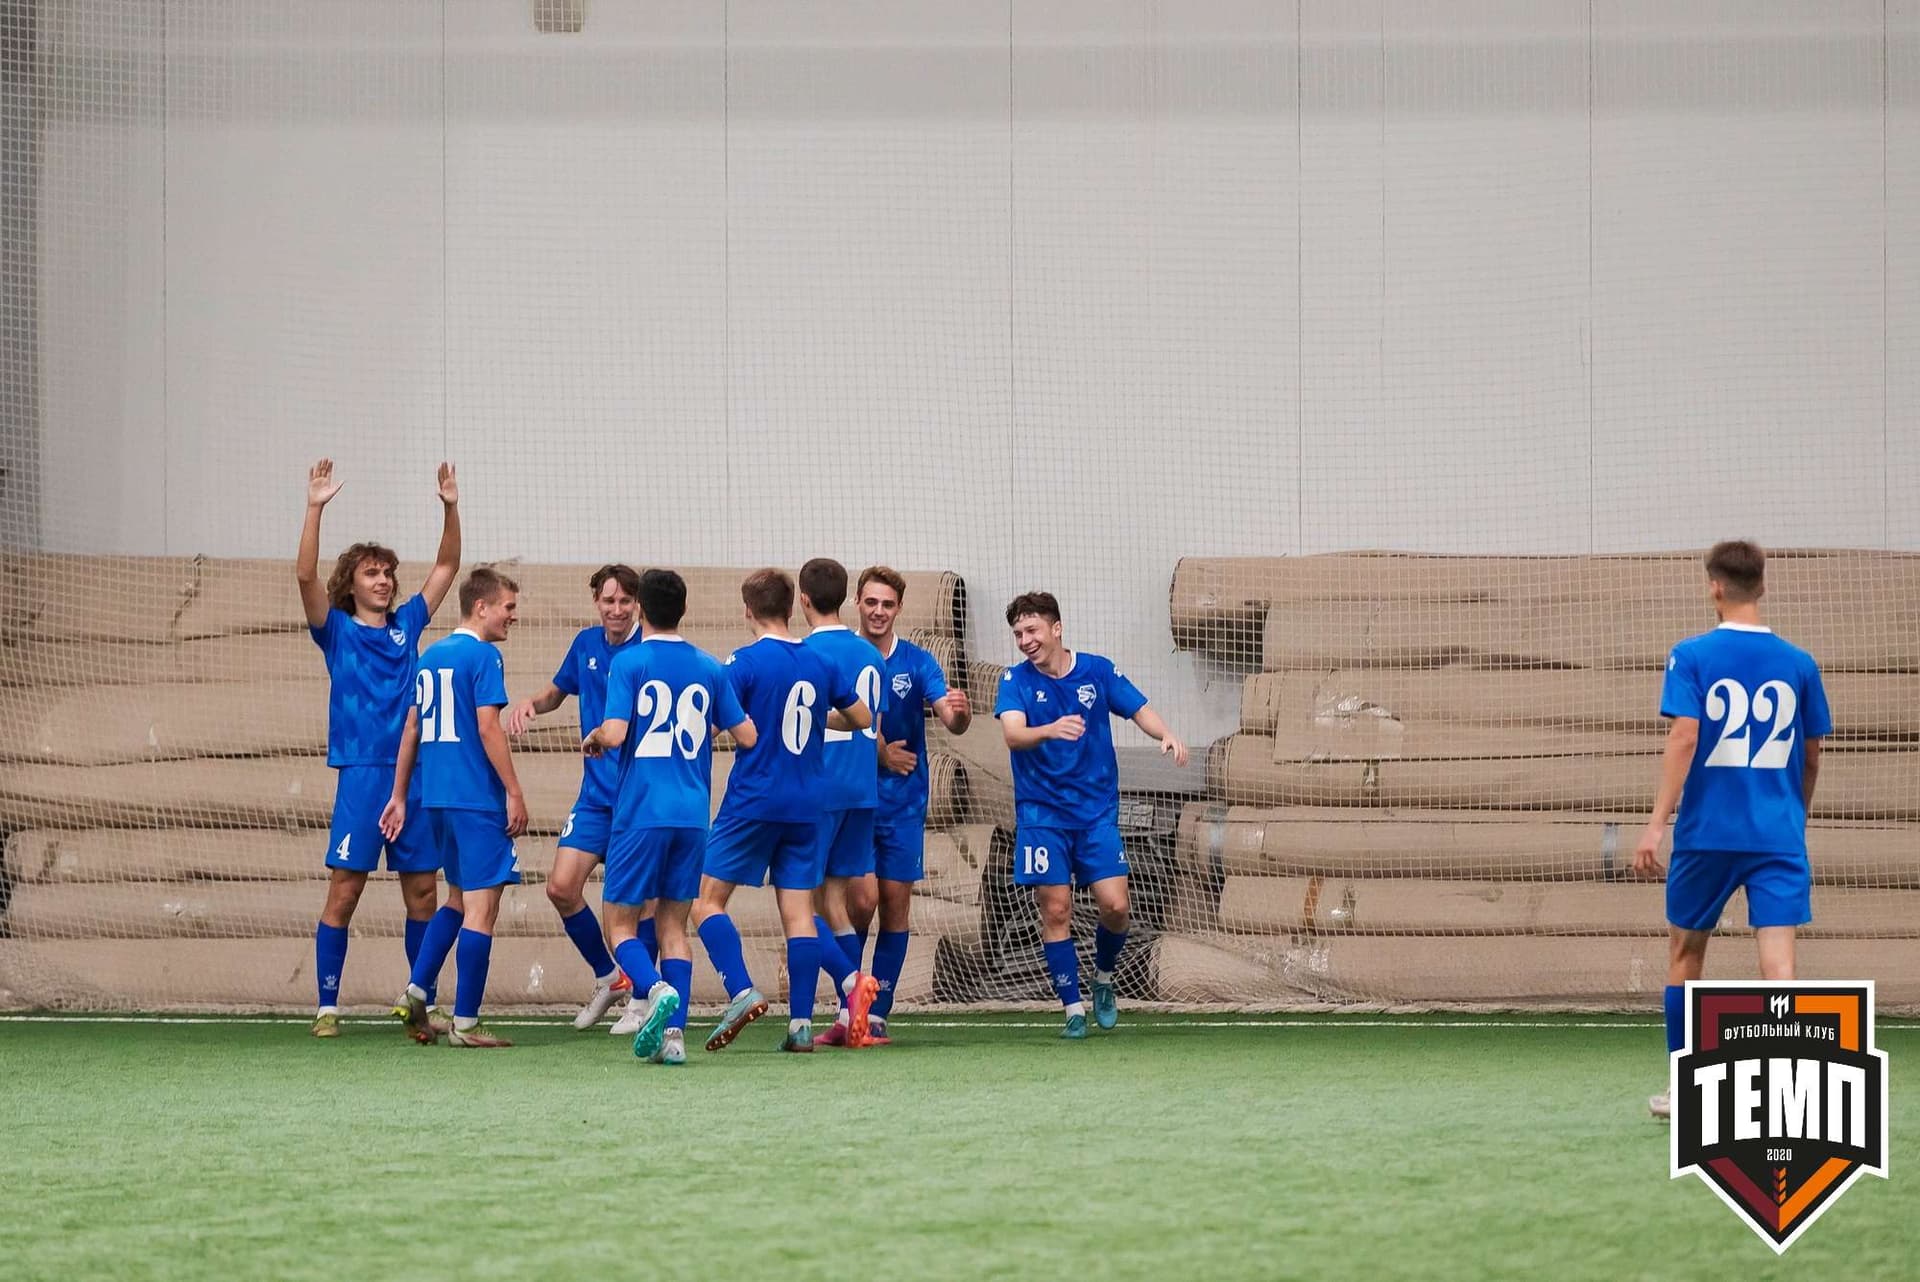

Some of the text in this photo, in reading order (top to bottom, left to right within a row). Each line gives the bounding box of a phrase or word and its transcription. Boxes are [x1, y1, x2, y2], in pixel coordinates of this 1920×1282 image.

[416, 668, 461, 743] 21
[634, 679, 710, 760] 28
[781, 680, 817, 755] 6
[1704, 678, 1797, 769] 22
[336, 832, 351, 861] 4
[1023, 846, 1049, 874] 18
